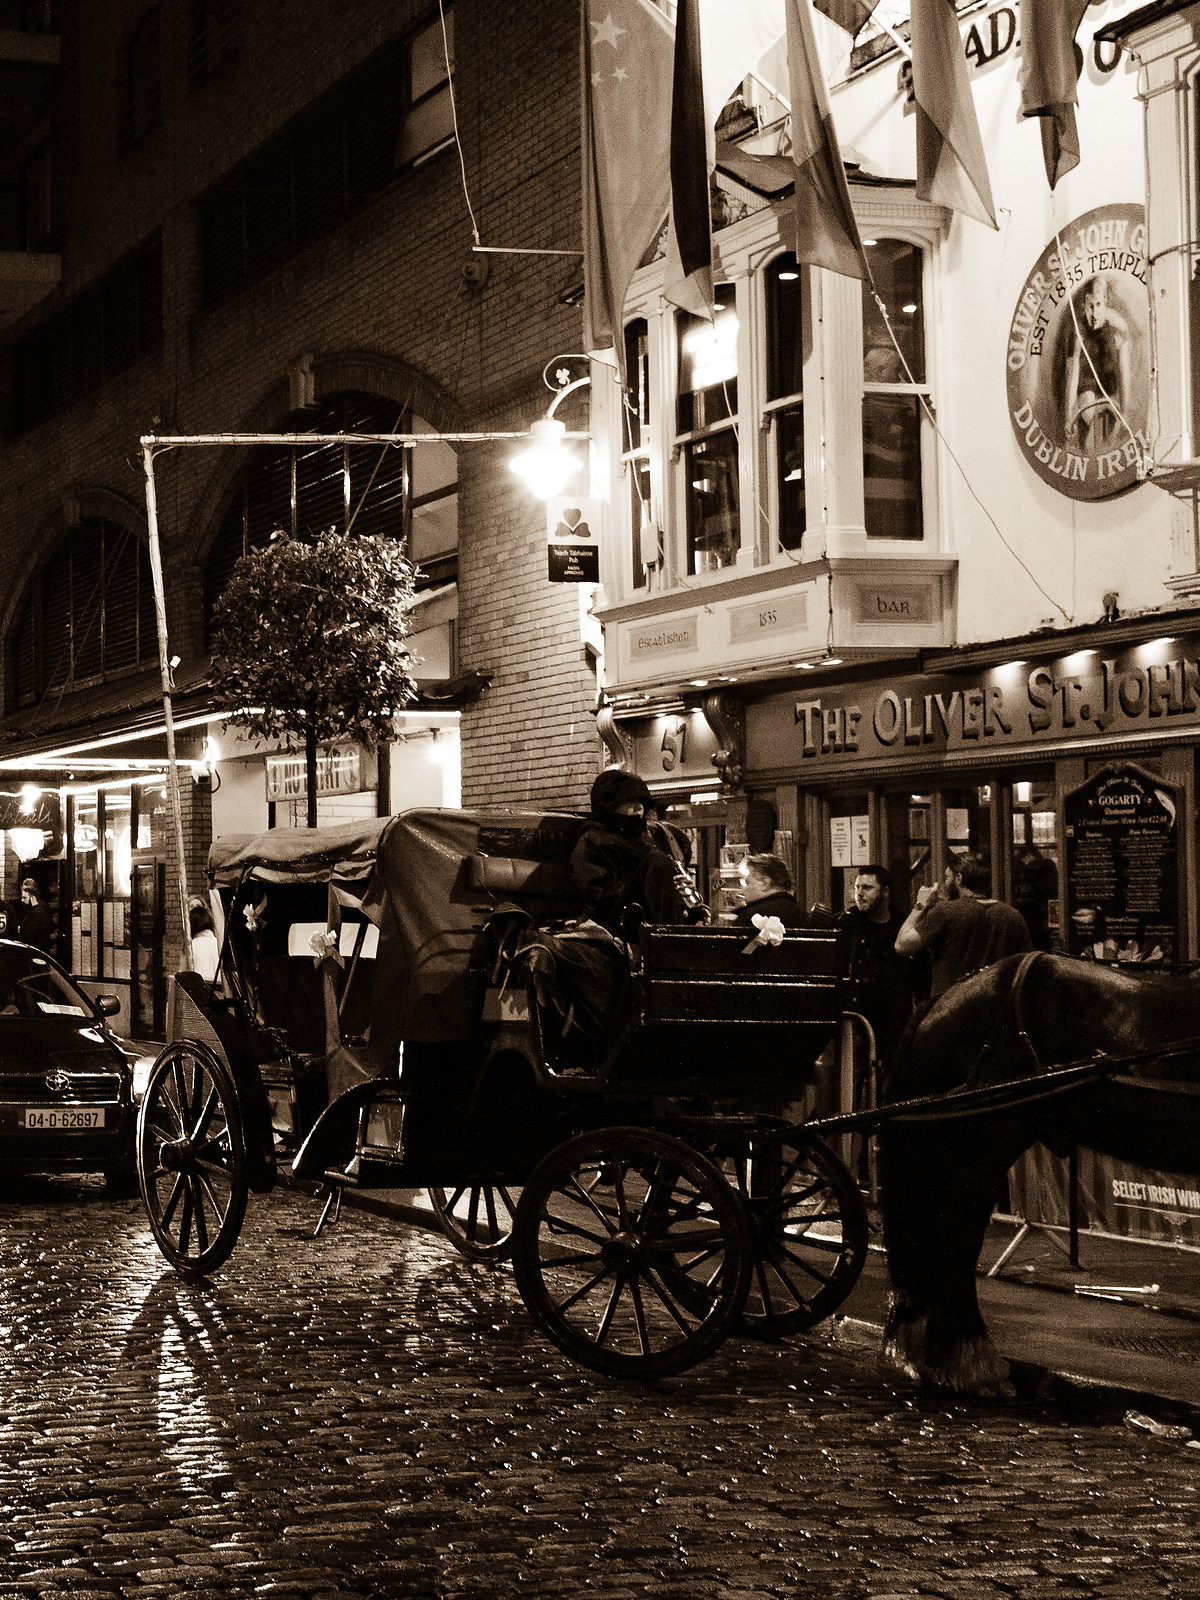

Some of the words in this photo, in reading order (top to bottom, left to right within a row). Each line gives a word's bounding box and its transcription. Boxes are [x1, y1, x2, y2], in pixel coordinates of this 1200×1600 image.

[1008, 271, 1050, 372] OLIVER
[1076, 220, 1128, 260] JOHN
[1030, 310, 1050, 357] EST
[1049, 264, 1084, 308] 1835
[1014, 400, 1090, 481] DUBLIN
[873, 686, 1012, 747] OLIVER
[1098, 794, 1142, 806] GOGARTY
[29, 1113, 99, 1127] 04-D-62697
[1112, 1180, 1147, 1201] SELECT
[1148, 1185, 1177, 1206] IRISH
